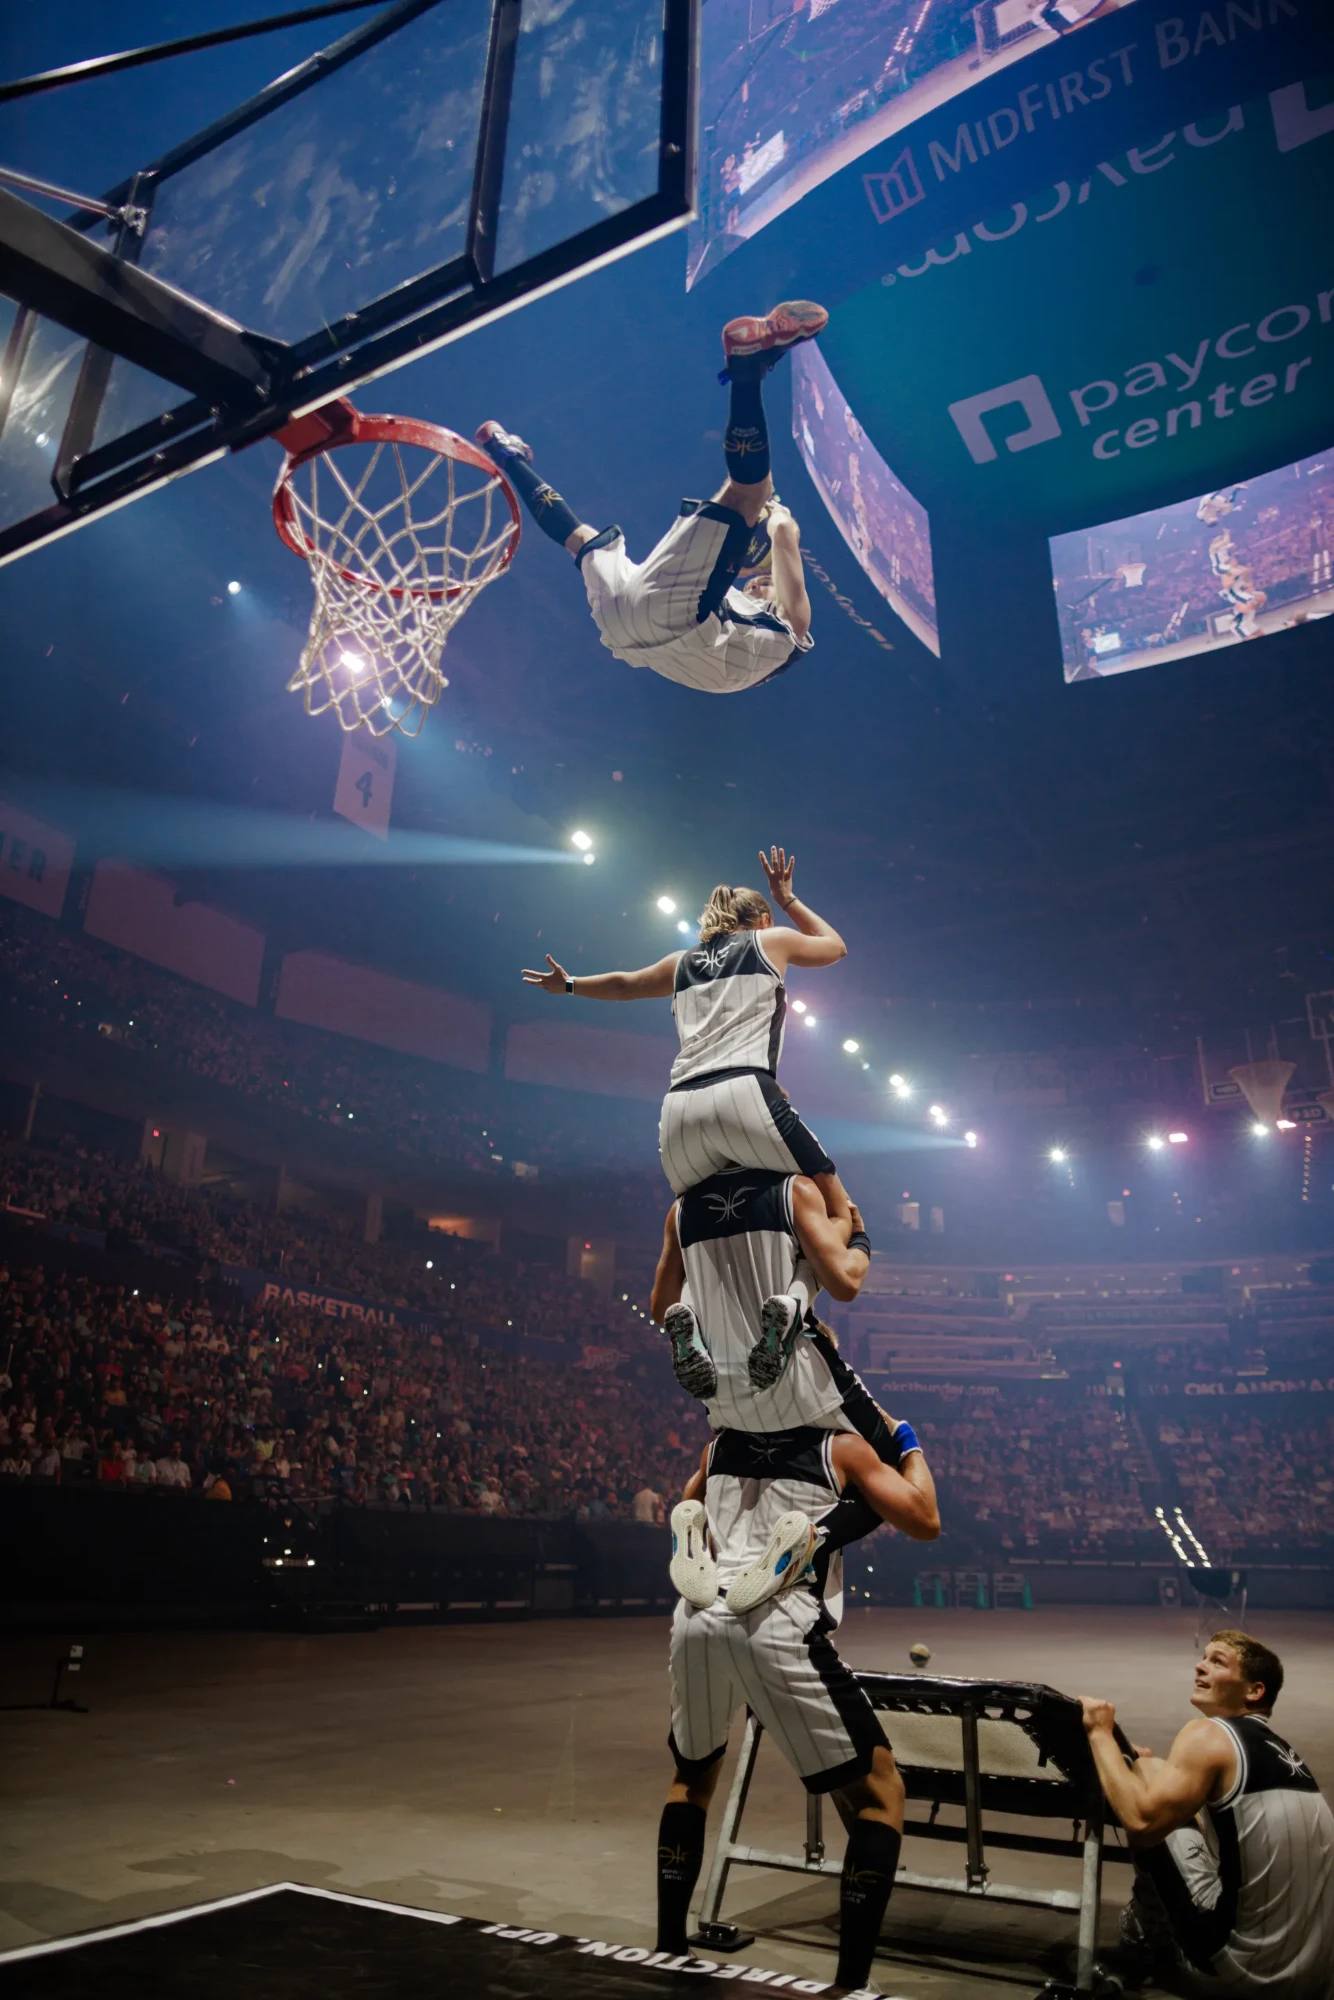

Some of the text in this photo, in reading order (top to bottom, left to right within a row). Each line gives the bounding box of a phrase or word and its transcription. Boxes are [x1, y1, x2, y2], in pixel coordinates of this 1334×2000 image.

[1069, 288, 1334, 427] payco
[1092, 357, 1312, 459] center
[355, 772, 373, 808] 4
[481, 1924, 560, 1946] UP!
